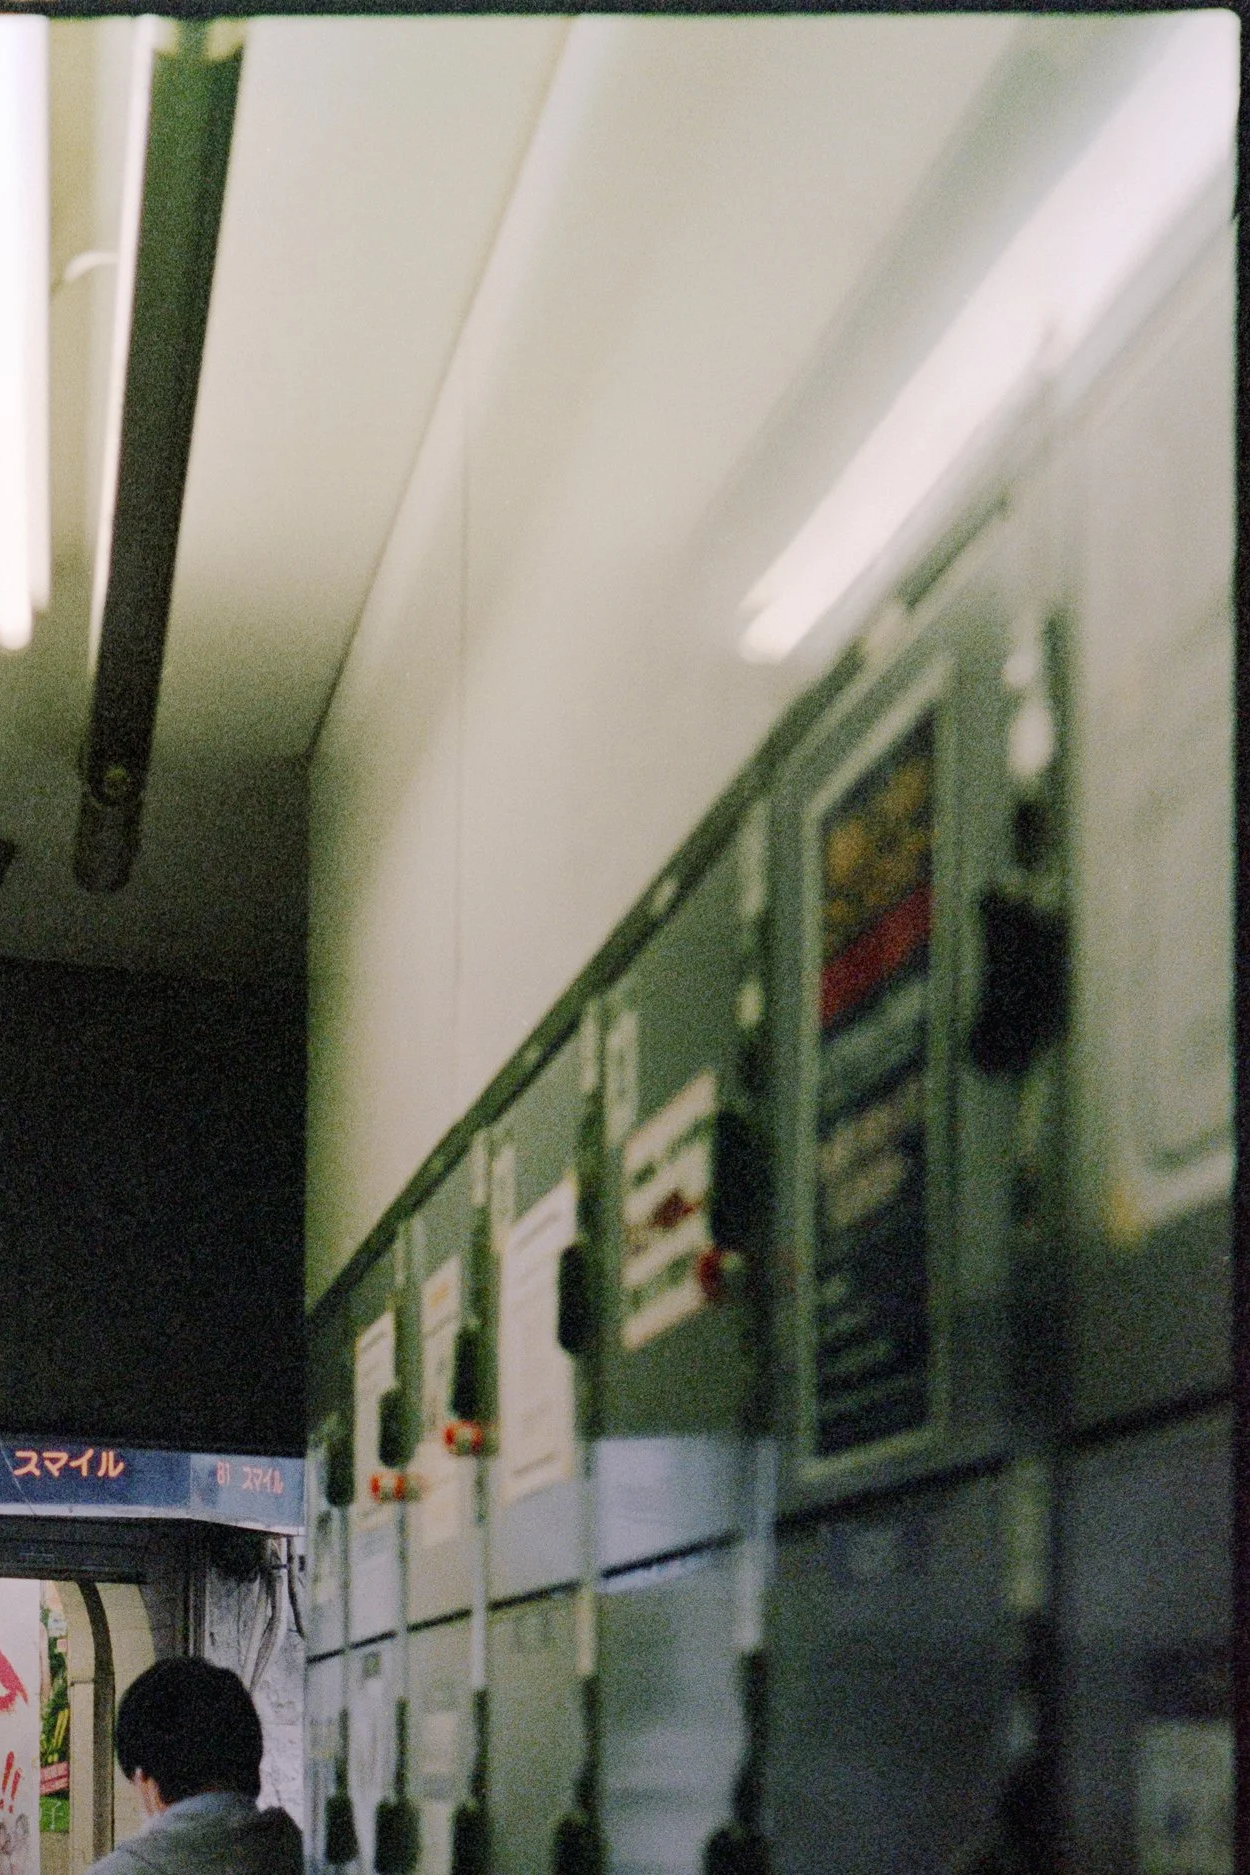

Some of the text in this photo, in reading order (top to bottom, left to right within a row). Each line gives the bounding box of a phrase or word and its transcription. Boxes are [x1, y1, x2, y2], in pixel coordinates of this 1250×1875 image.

[13, 1448, 125, 1478] スマイル
[242, 1466, 283, 1495] スマイル
